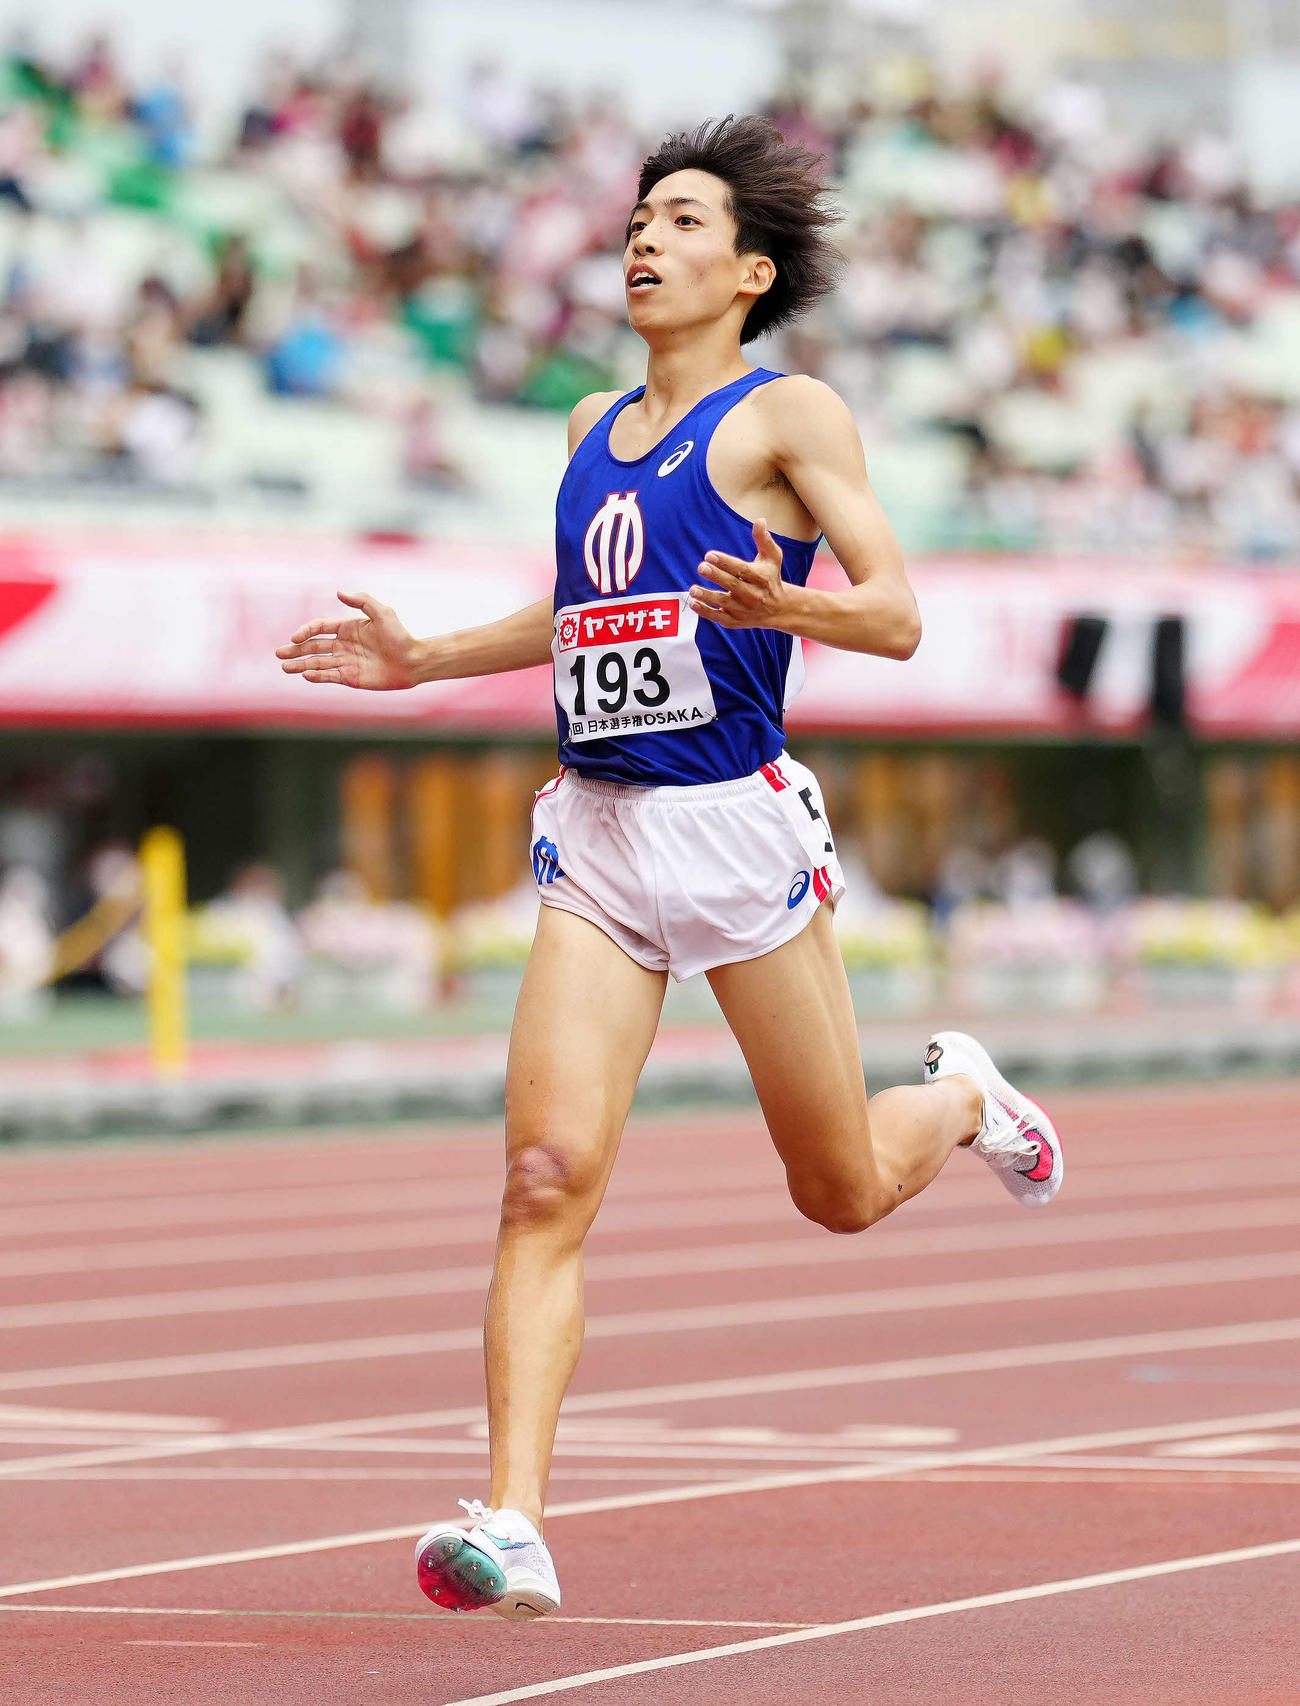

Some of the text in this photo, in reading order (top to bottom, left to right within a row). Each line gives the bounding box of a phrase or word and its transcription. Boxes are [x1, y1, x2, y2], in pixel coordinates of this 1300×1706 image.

[584, 608, 671, 638] ヤマザキ
[570, 647, 670, 715] 193
